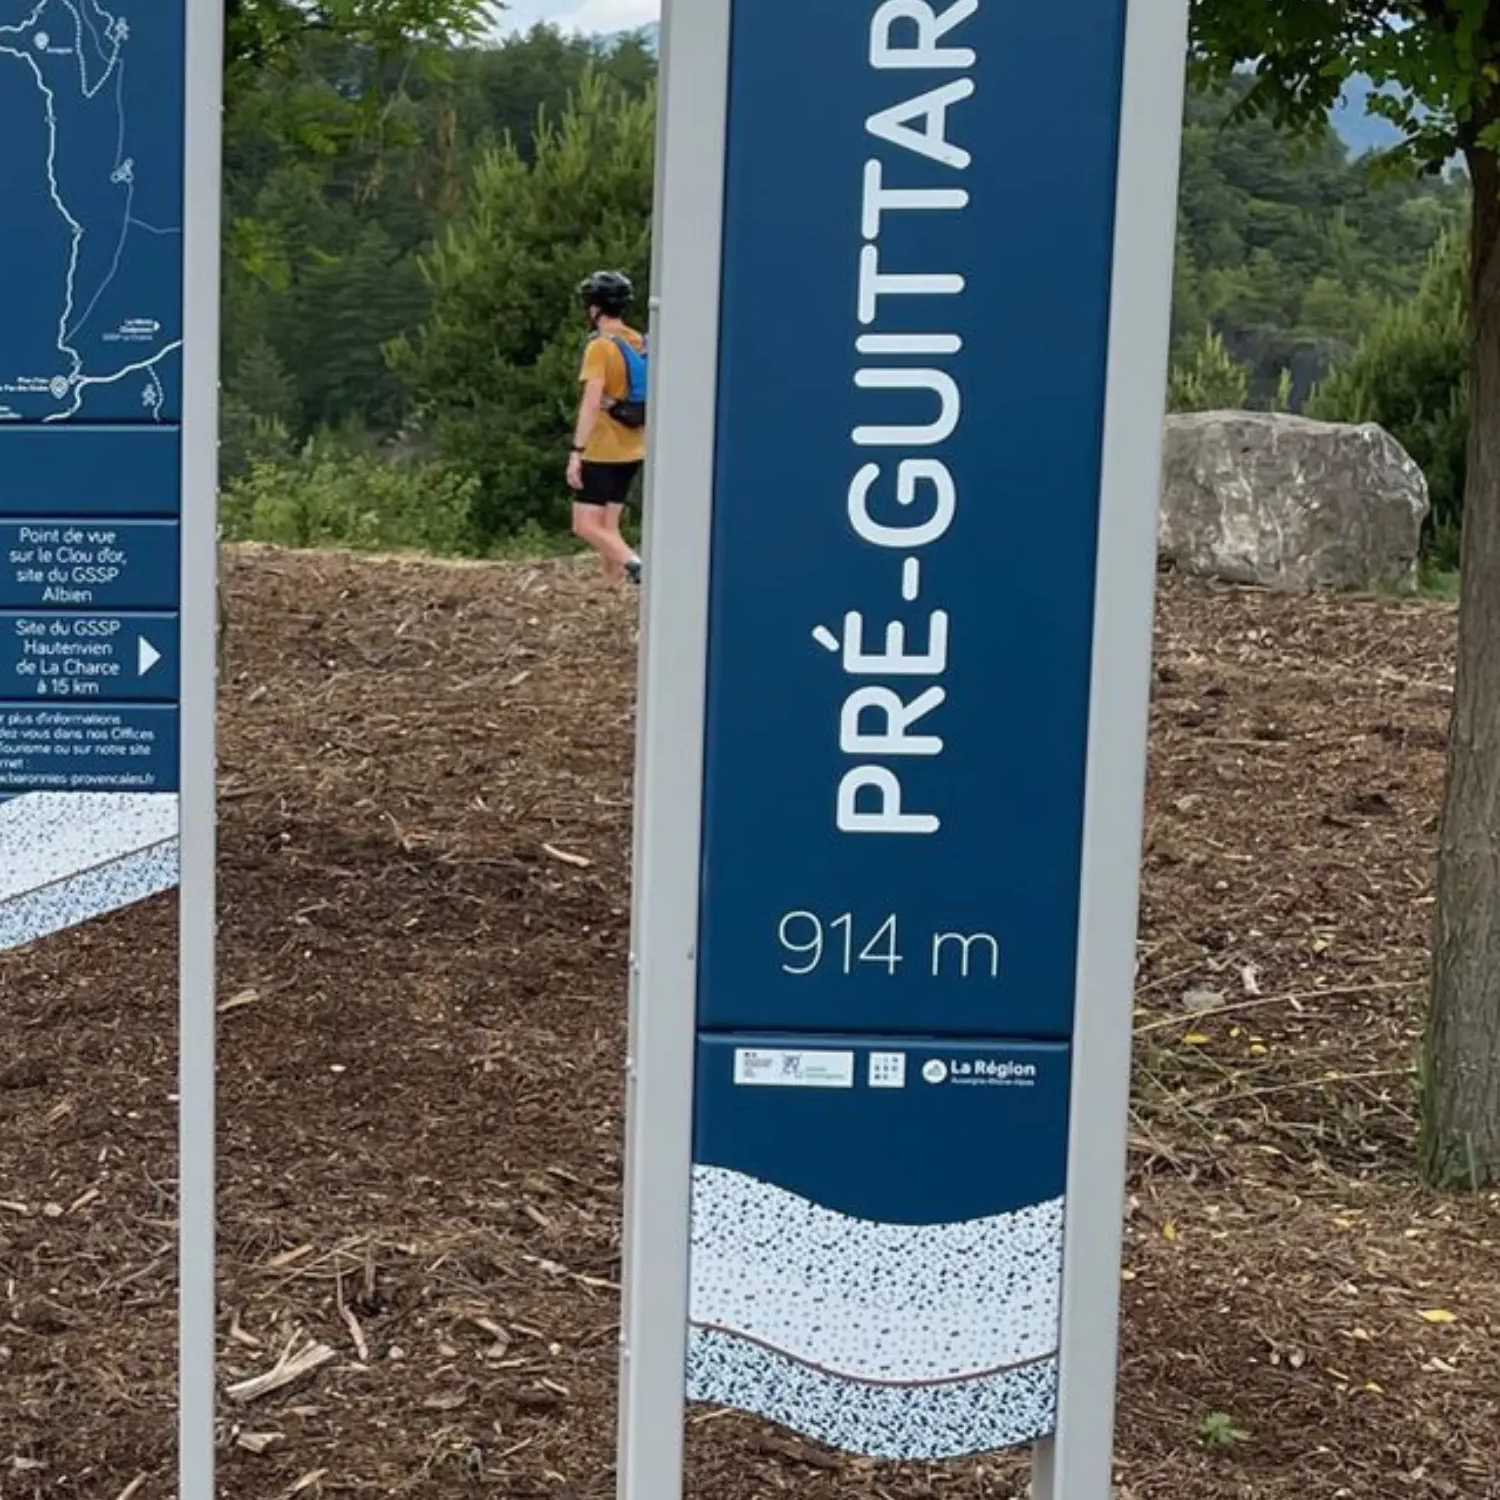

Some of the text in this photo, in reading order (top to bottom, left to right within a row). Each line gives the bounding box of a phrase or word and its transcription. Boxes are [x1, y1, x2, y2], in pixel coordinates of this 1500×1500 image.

[19, 527, 116, 543] Point de vue
[9, 551, 35, 562] sur
[37, 547, 53, 562] le
[56, 547, 93, 563] Clou
[16, 567, 119, 582] site du GSSP
[42, 586, 92, 602] Albien
[15, 619, 120, 636] Site du GSSP
[16, 659, 120, 676] de La Charce
[37, 678, 100, 694] à 15 km
[8, 712, 34, 727] plus
[53, 727, 83, 740] dans
[111, 726, 155, 741] Offices
[53, 745, 70, 754] ou
[73, 745, 92, 754] sur
[776, 909, 999, 977] 914 m
[951, 1059, 1037, 1080] La Région
